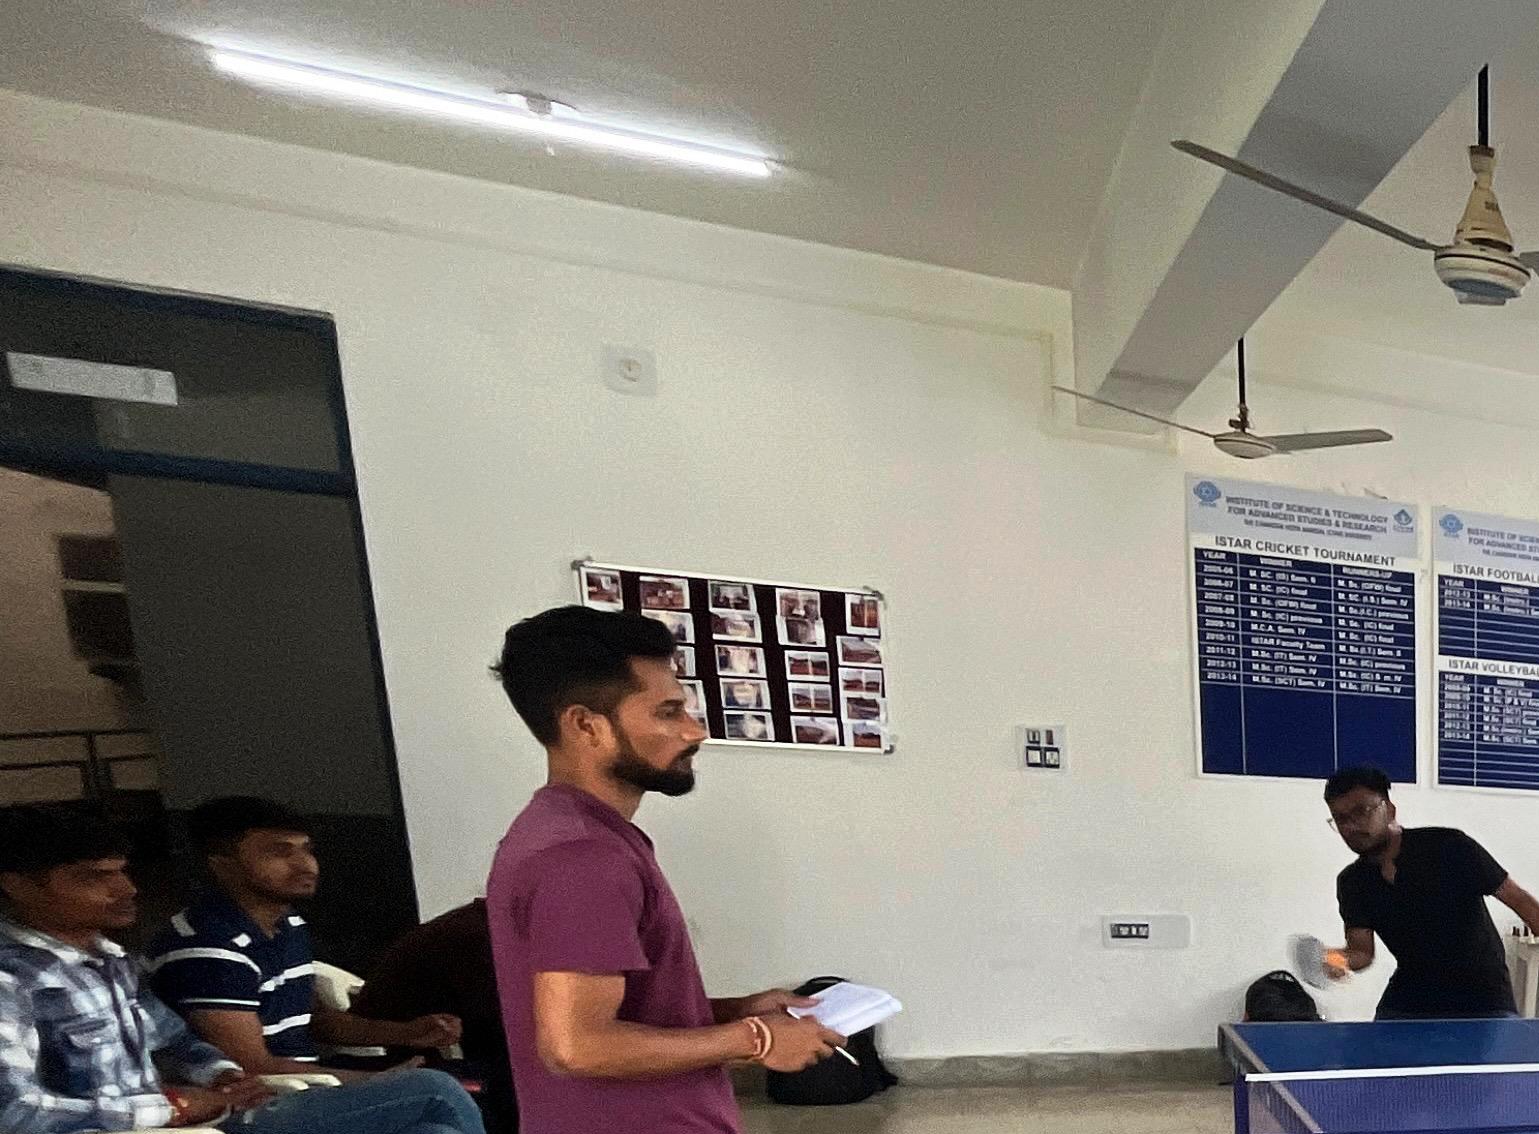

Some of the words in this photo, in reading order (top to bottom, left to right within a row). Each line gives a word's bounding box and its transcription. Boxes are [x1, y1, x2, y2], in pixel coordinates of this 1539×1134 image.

[1226, 496, 1270, 508] INSTITUTE
[1272, 501, 1283, 510] OF
[1286, 503, 1322, 514] SCIENCE
[1332, 510, 1389, 523] TECHNOLOGY
[1228, 506, 1246, 516] FOR
[1248, 510, 1296, 522] ADVANCED
[1297, 514, 1333, 526] STUDIES
[1334, 519, 1341, 528] &
[1342, 520, 1388, 534] RESEARCH
[1507, 533, 1517, 541] OF
[1469, 538, 1484, 546] FOR
[1486, 540, 1526, 551] ADVANCED
[1203, 551, 1226, 560] YEAR
[1215, 536, 1253, 550] ISTAR
[1256, 541, 1310, 557] CRICKET
[1314, 548, 1397, 567] TOURNAMENT
[1453, 564, 1484, 577] ISTAR
[1448, 660, 1479, 671] ISTAR
